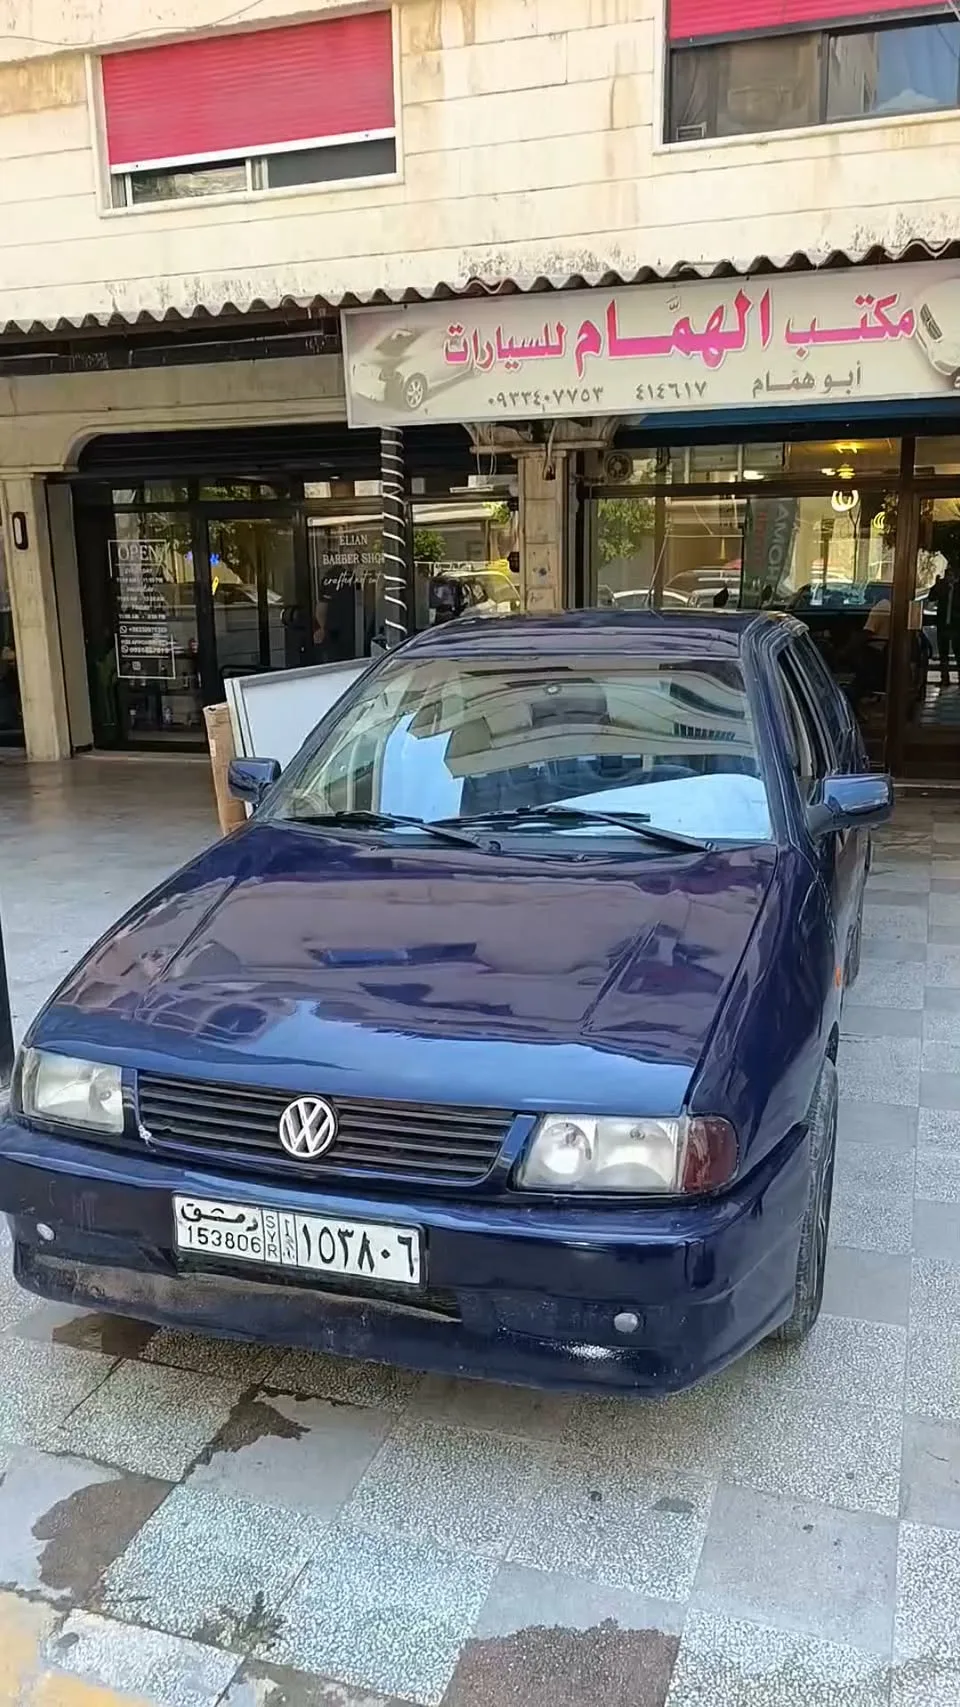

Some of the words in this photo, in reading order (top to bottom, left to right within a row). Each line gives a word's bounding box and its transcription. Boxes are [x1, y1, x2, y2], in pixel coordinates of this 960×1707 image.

[785, 293, 916, 359] مكتب
[443, 320, 567, 372] للسيارات
[488, 386, 604, 408] ٠٩٣٣٤٠٧٧٥٣
[635, 380, 707, 401] ٤١٤٦١٧
[117, 543, 163, 561] OPEN
[340, 535, 368, 546] ELIAN
[322, 553, 360, 566] BARBER
[180, 1203, 259, 1232] دمشق
[186, 1225, 262, 1254] 153806
[265, 1215, 278, 1258] SYR
[302, 1223, 416, 1278] ١٥٣٨٠٦
